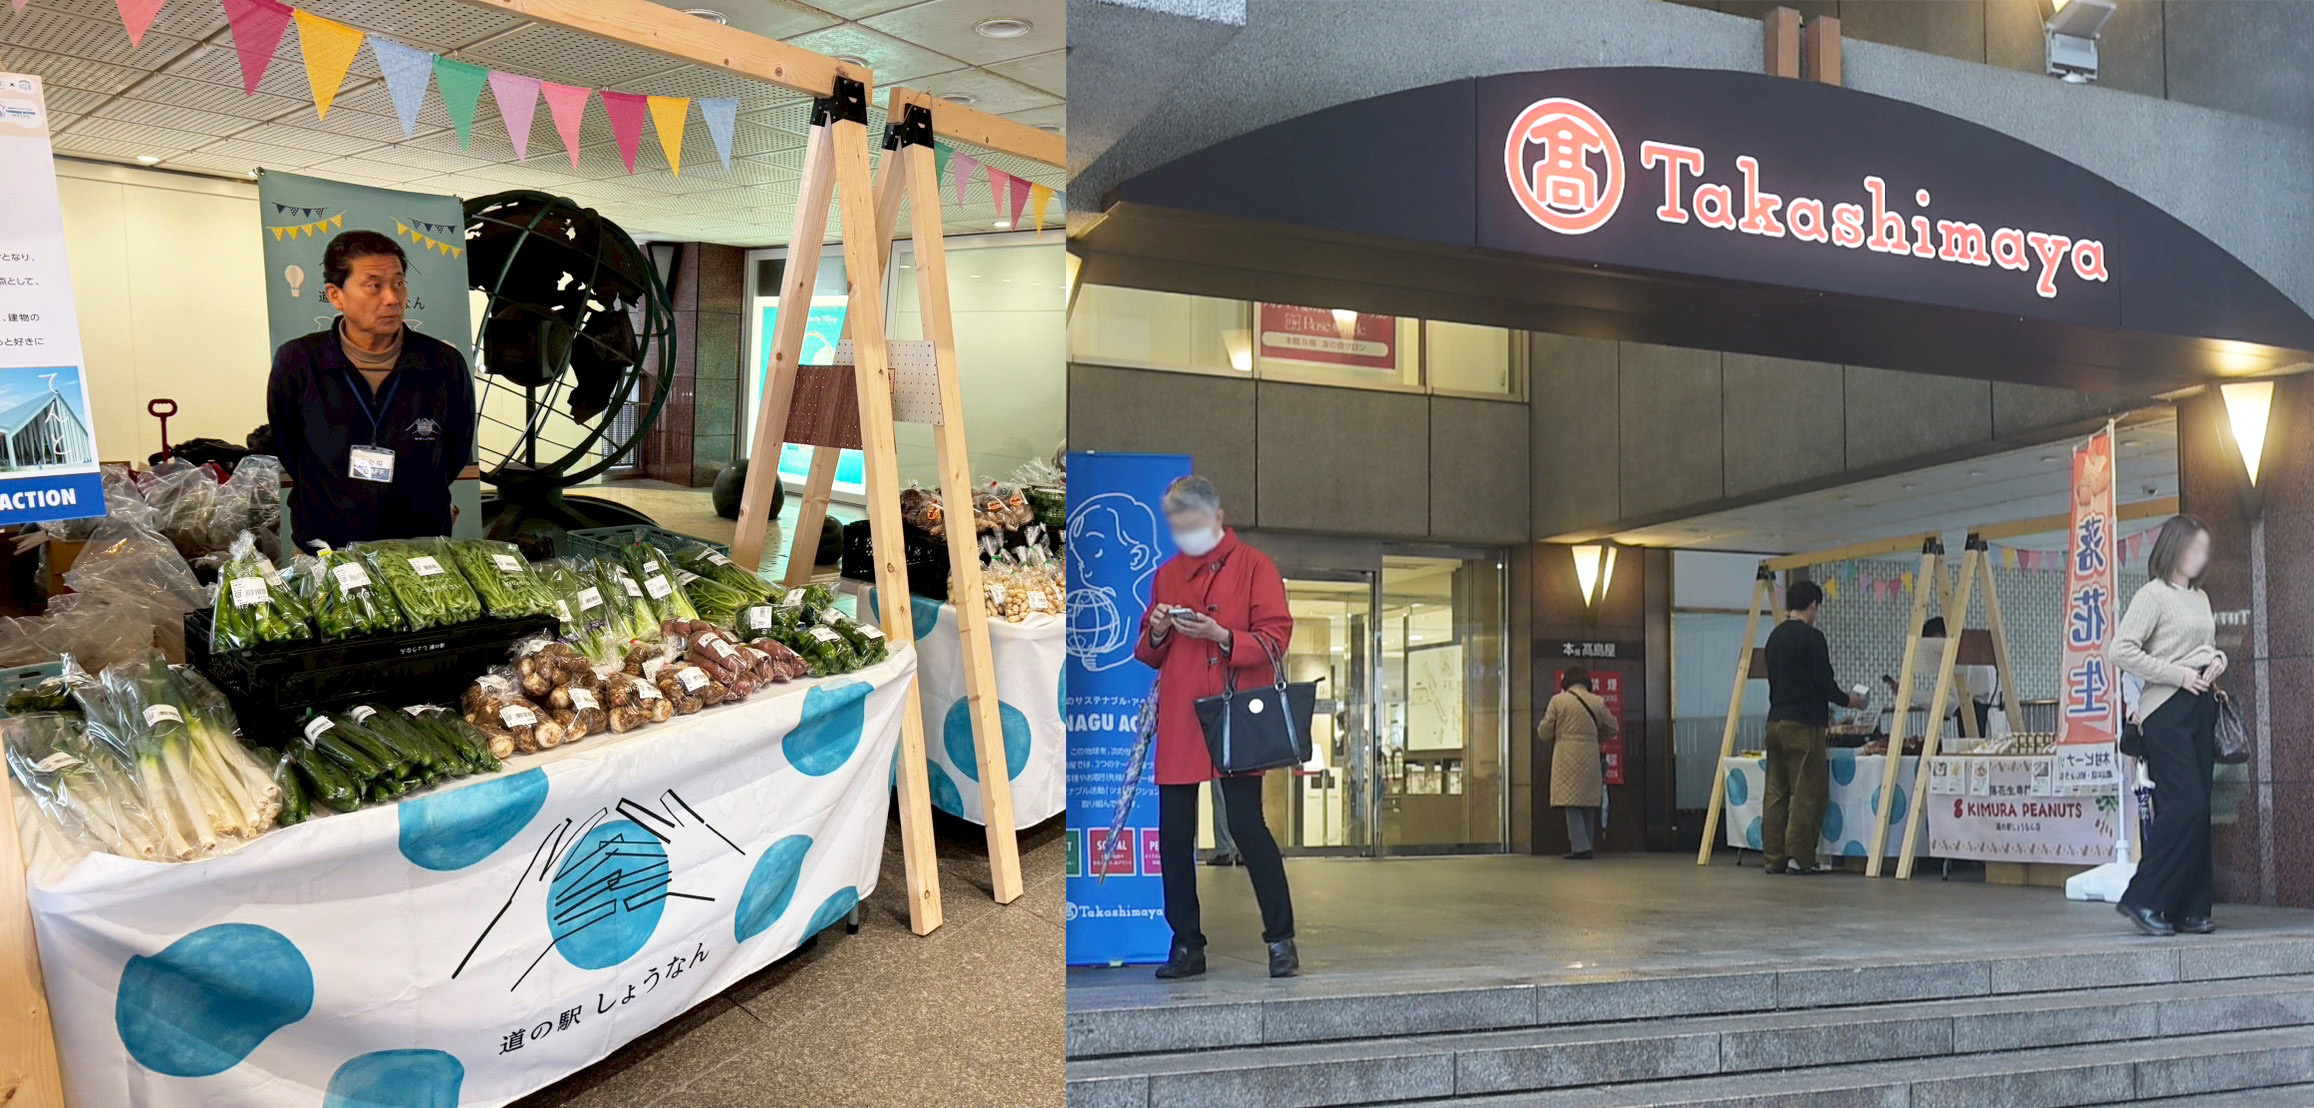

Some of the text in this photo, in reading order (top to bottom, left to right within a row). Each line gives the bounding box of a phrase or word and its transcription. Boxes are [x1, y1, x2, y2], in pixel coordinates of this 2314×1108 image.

[1640, 139, 2109, 298] Takashimaya
[0, 253, 35, 261] となり、
[1303, 316, 1332, 333] Rose
[37, 372, 71, 455] てんと
[0, 488, 77, 511] ACTION
[1967, 802, 2083, 819] KIMURA PEANUTS
[1079, 904, 1163, 919] Takashimaya
[499, 942, 710, 1055] 道の駅 しょうなん
